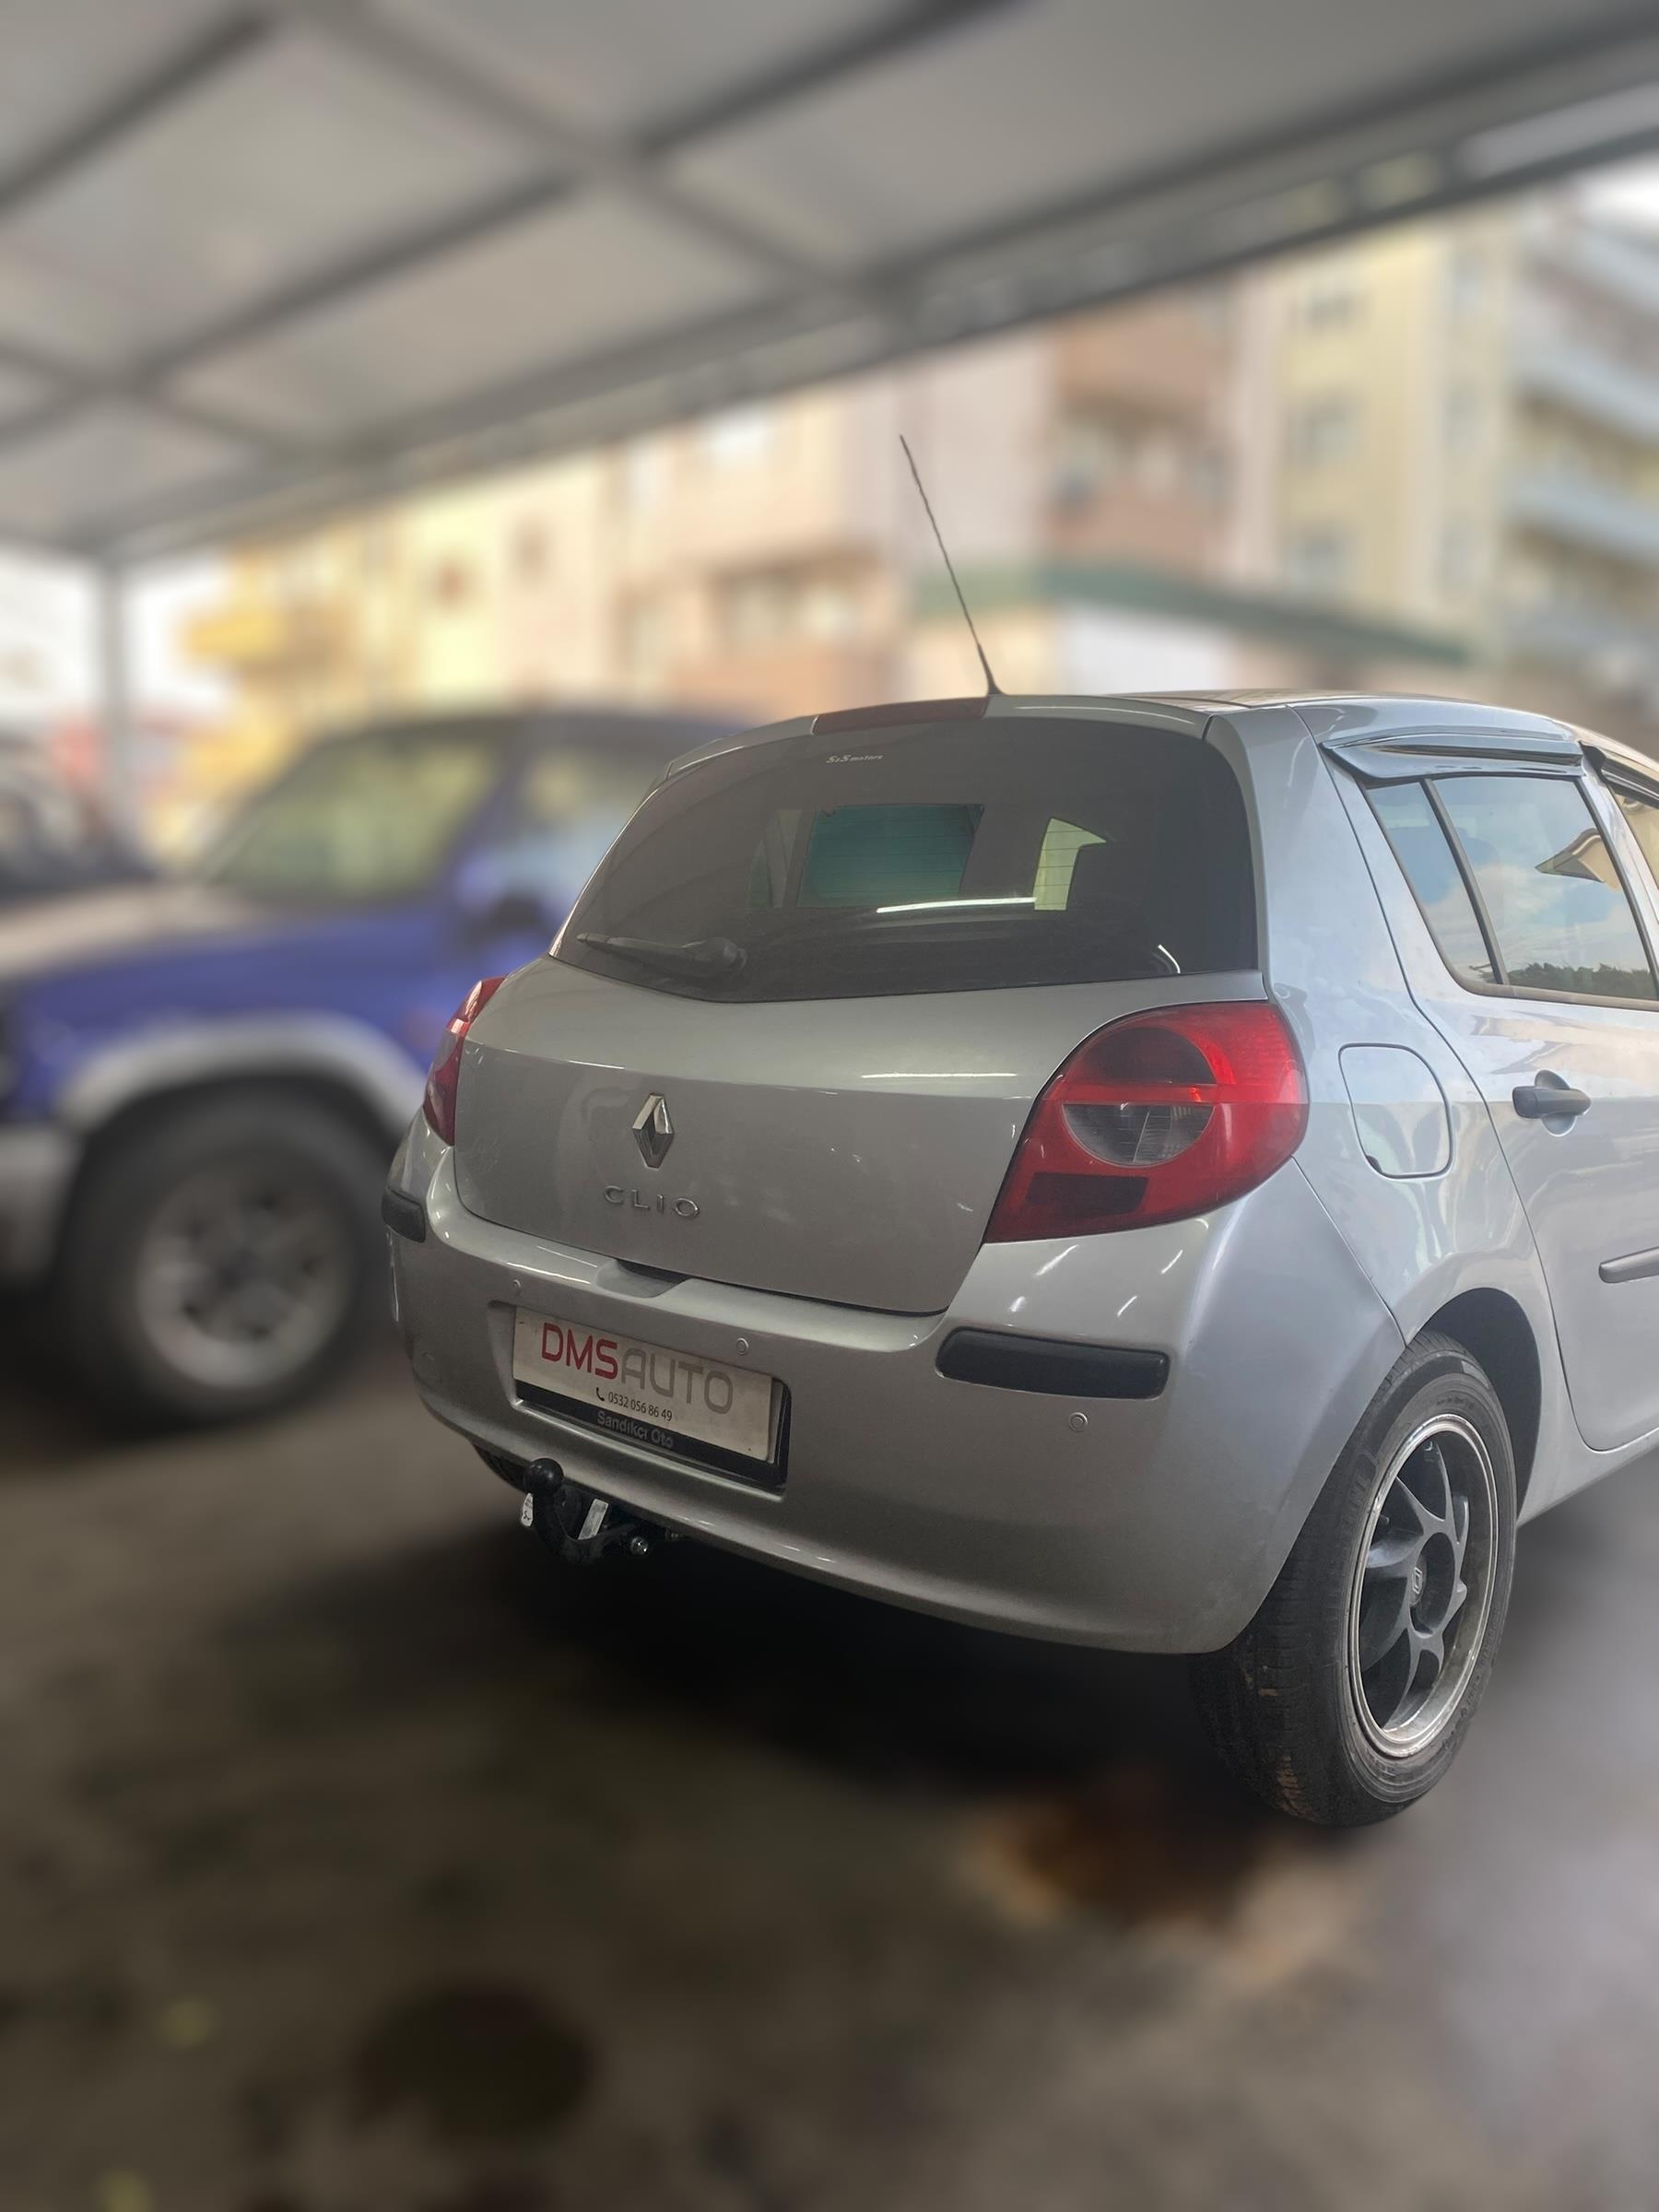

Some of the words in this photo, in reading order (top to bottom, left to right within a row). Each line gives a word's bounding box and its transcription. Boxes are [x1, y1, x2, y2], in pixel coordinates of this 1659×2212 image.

[605, 1185, 700, 1218] CLIO
[608, 1392, 629, 1408] 0532
[630, 1399, 646, 1414] 056
[648, 1404, 659, 1418] 86
[661, 1408, 673, 1421] 49
[651, 1429, 674, 1449] Oto
